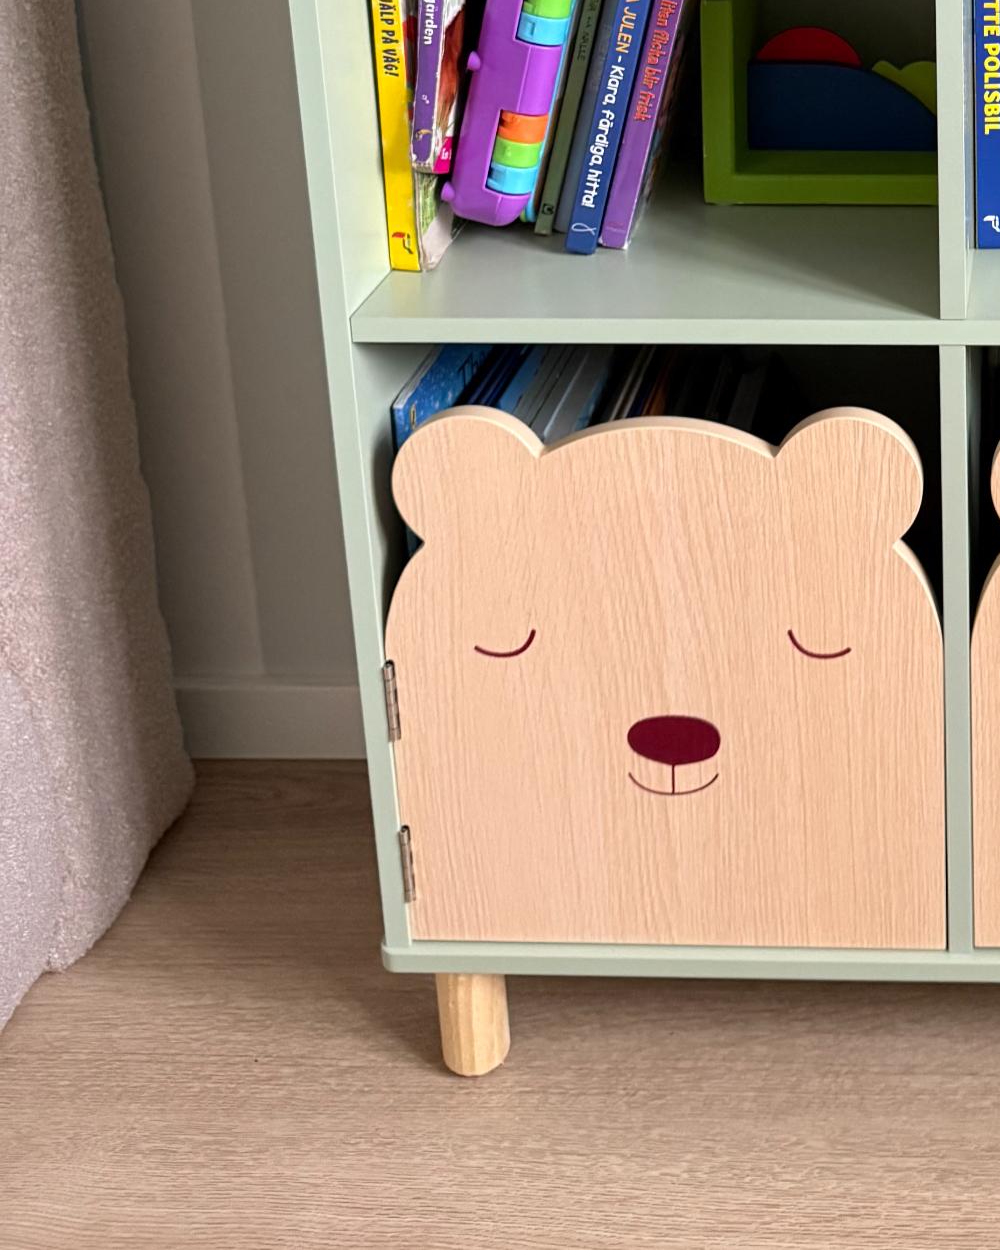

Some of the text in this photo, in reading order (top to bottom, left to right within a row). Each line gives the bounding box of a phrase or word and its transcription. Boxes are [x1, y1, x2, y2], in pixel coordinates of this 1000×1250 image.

[616, 6, 637, 54] JULEN
[656, 0, 678, 26] liten
[382, 29, 398, 44] PÅ
[646, 29, 669, 65] flicka
[382, 48, 399, 77] VÄG!
[641, 66, 661, 89] blir
[602, 64, 626, 106] Klara,
[983, 43, 1000, 135] POLISBIL
[634, 91, 655, 122] frisk
[588, 110, 615, 166] färdiga,
[581, 169, 603, 208] hitta!
